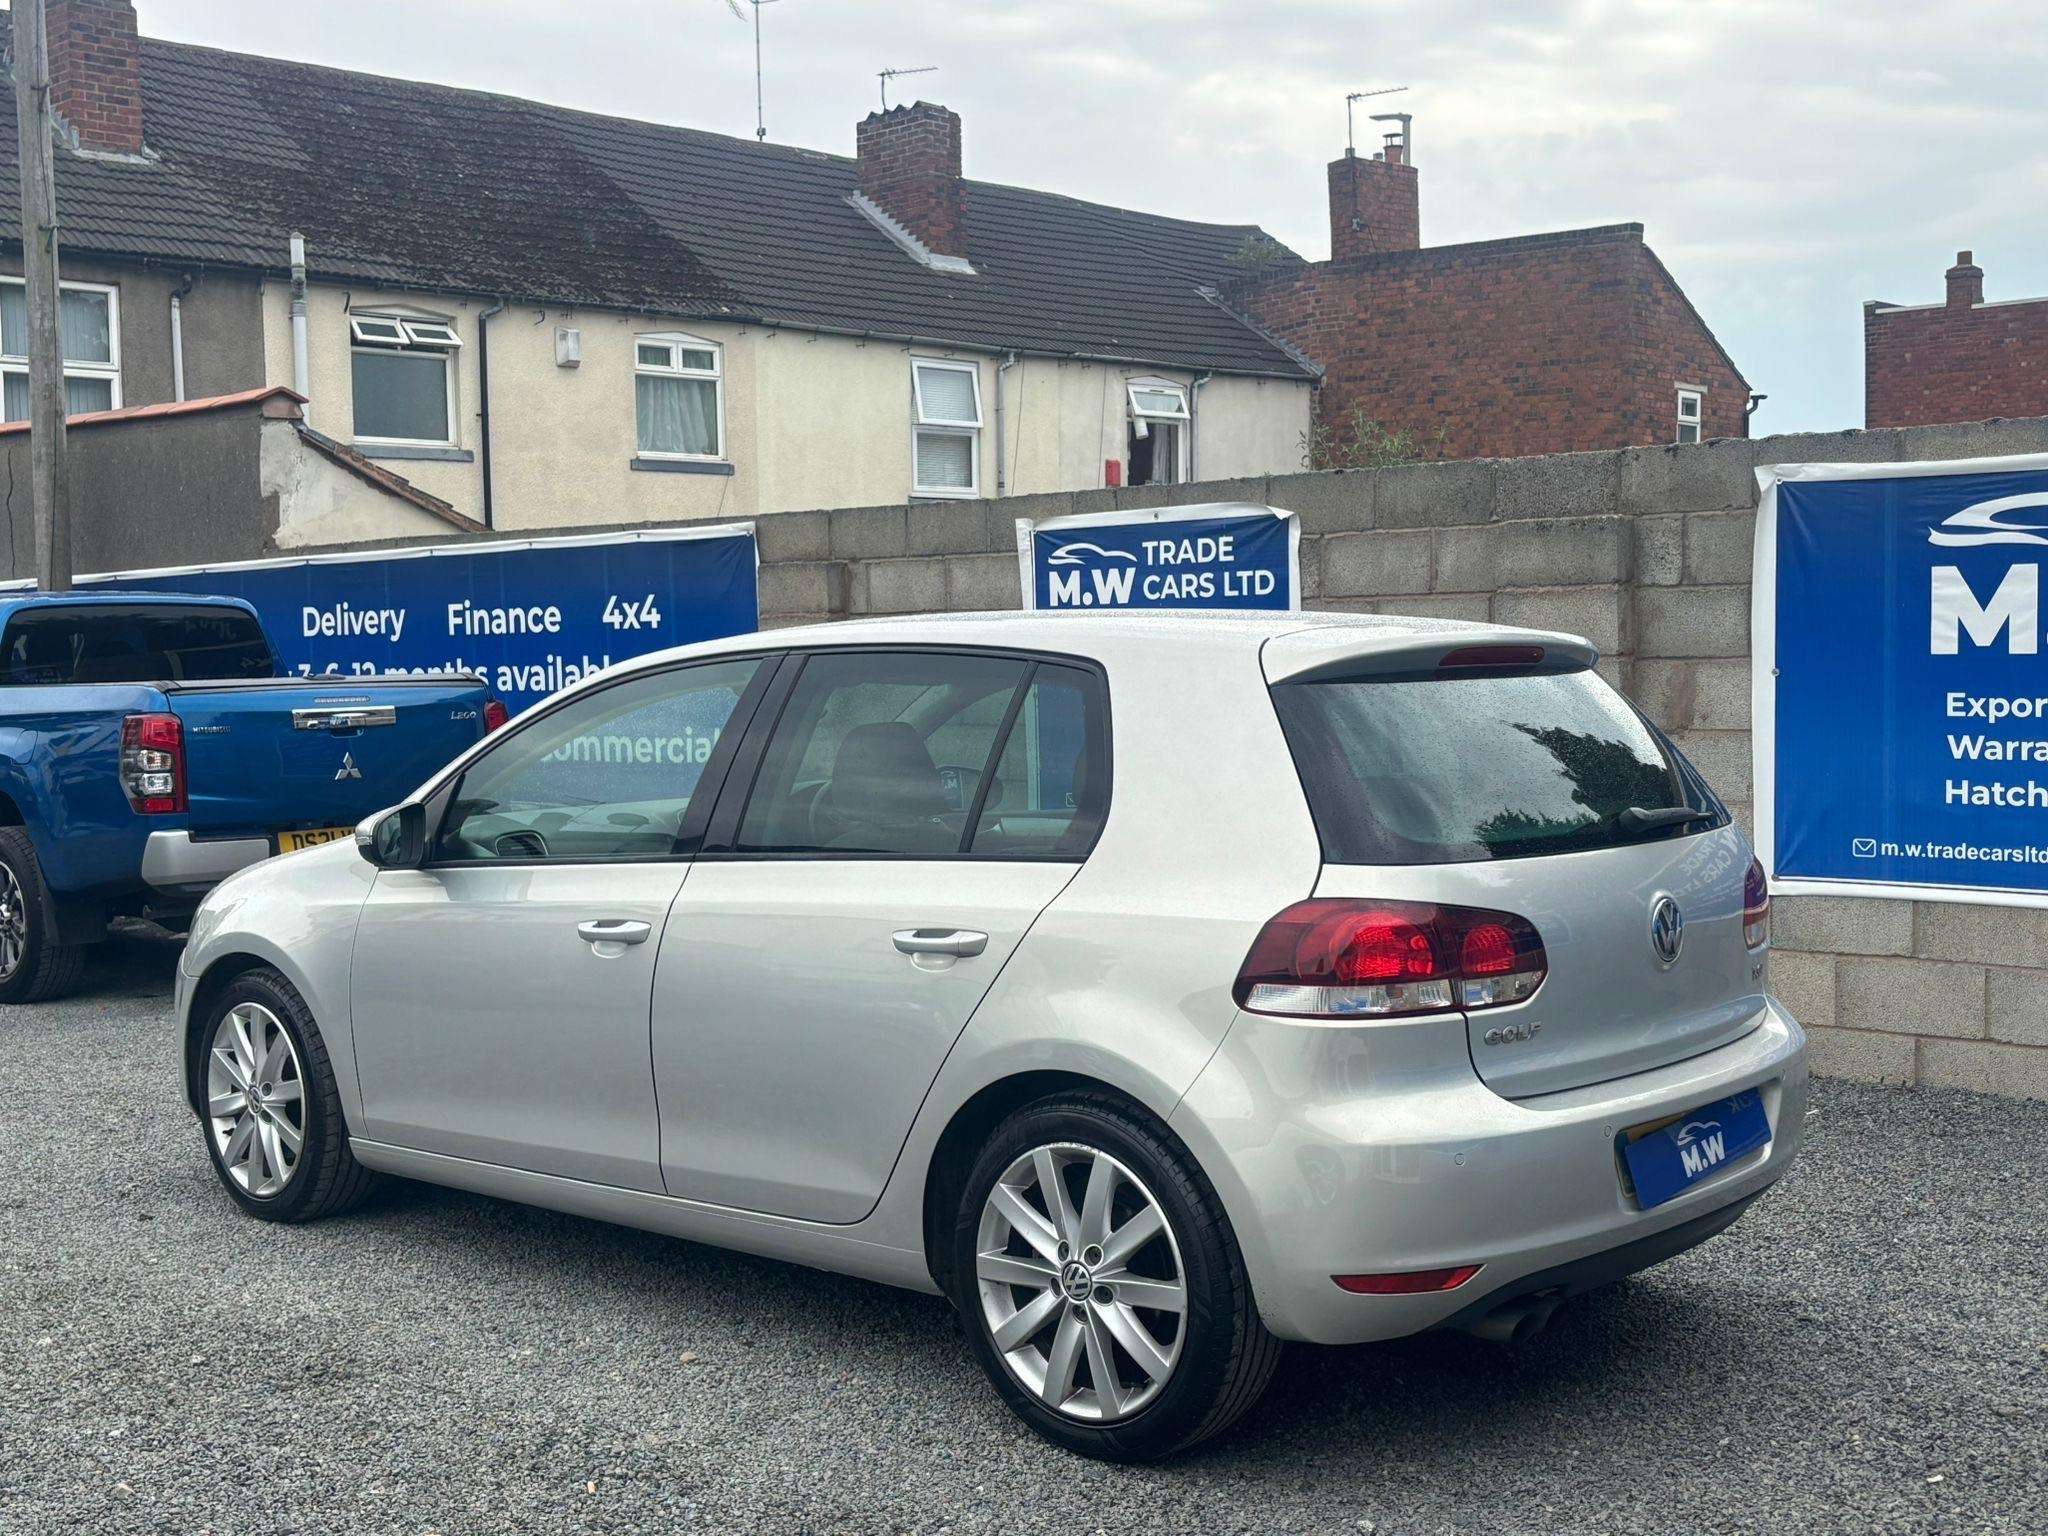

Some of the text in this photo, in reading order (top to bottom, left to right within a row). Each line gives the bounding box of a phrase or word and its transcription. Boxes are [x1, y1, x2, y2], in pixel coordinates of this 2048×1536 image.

[1142, 536, 1235, 566] TRADE
[1049, 567, 1136, 606] M.W
[1143, 570, 1275, 600] CARS LTD
[303, 601, 405, 642] Delivery
[448, 599, 562, 636] Finance
[602, 594, 662, 630] 4x4
[1931, 563, 2048, 655] M
[497, 654, 611, 692] availab
[1947, 692, 2048, 724] Expor
[541, 726, 720, 764] ommercia
[1947, 735, 2048, 762] Warra
[1946, 780, 2048, 807] Hatch
[1484, 1021, 1542, 1046] GOLF
[1680, 1131, 1726, 1178] M.W
